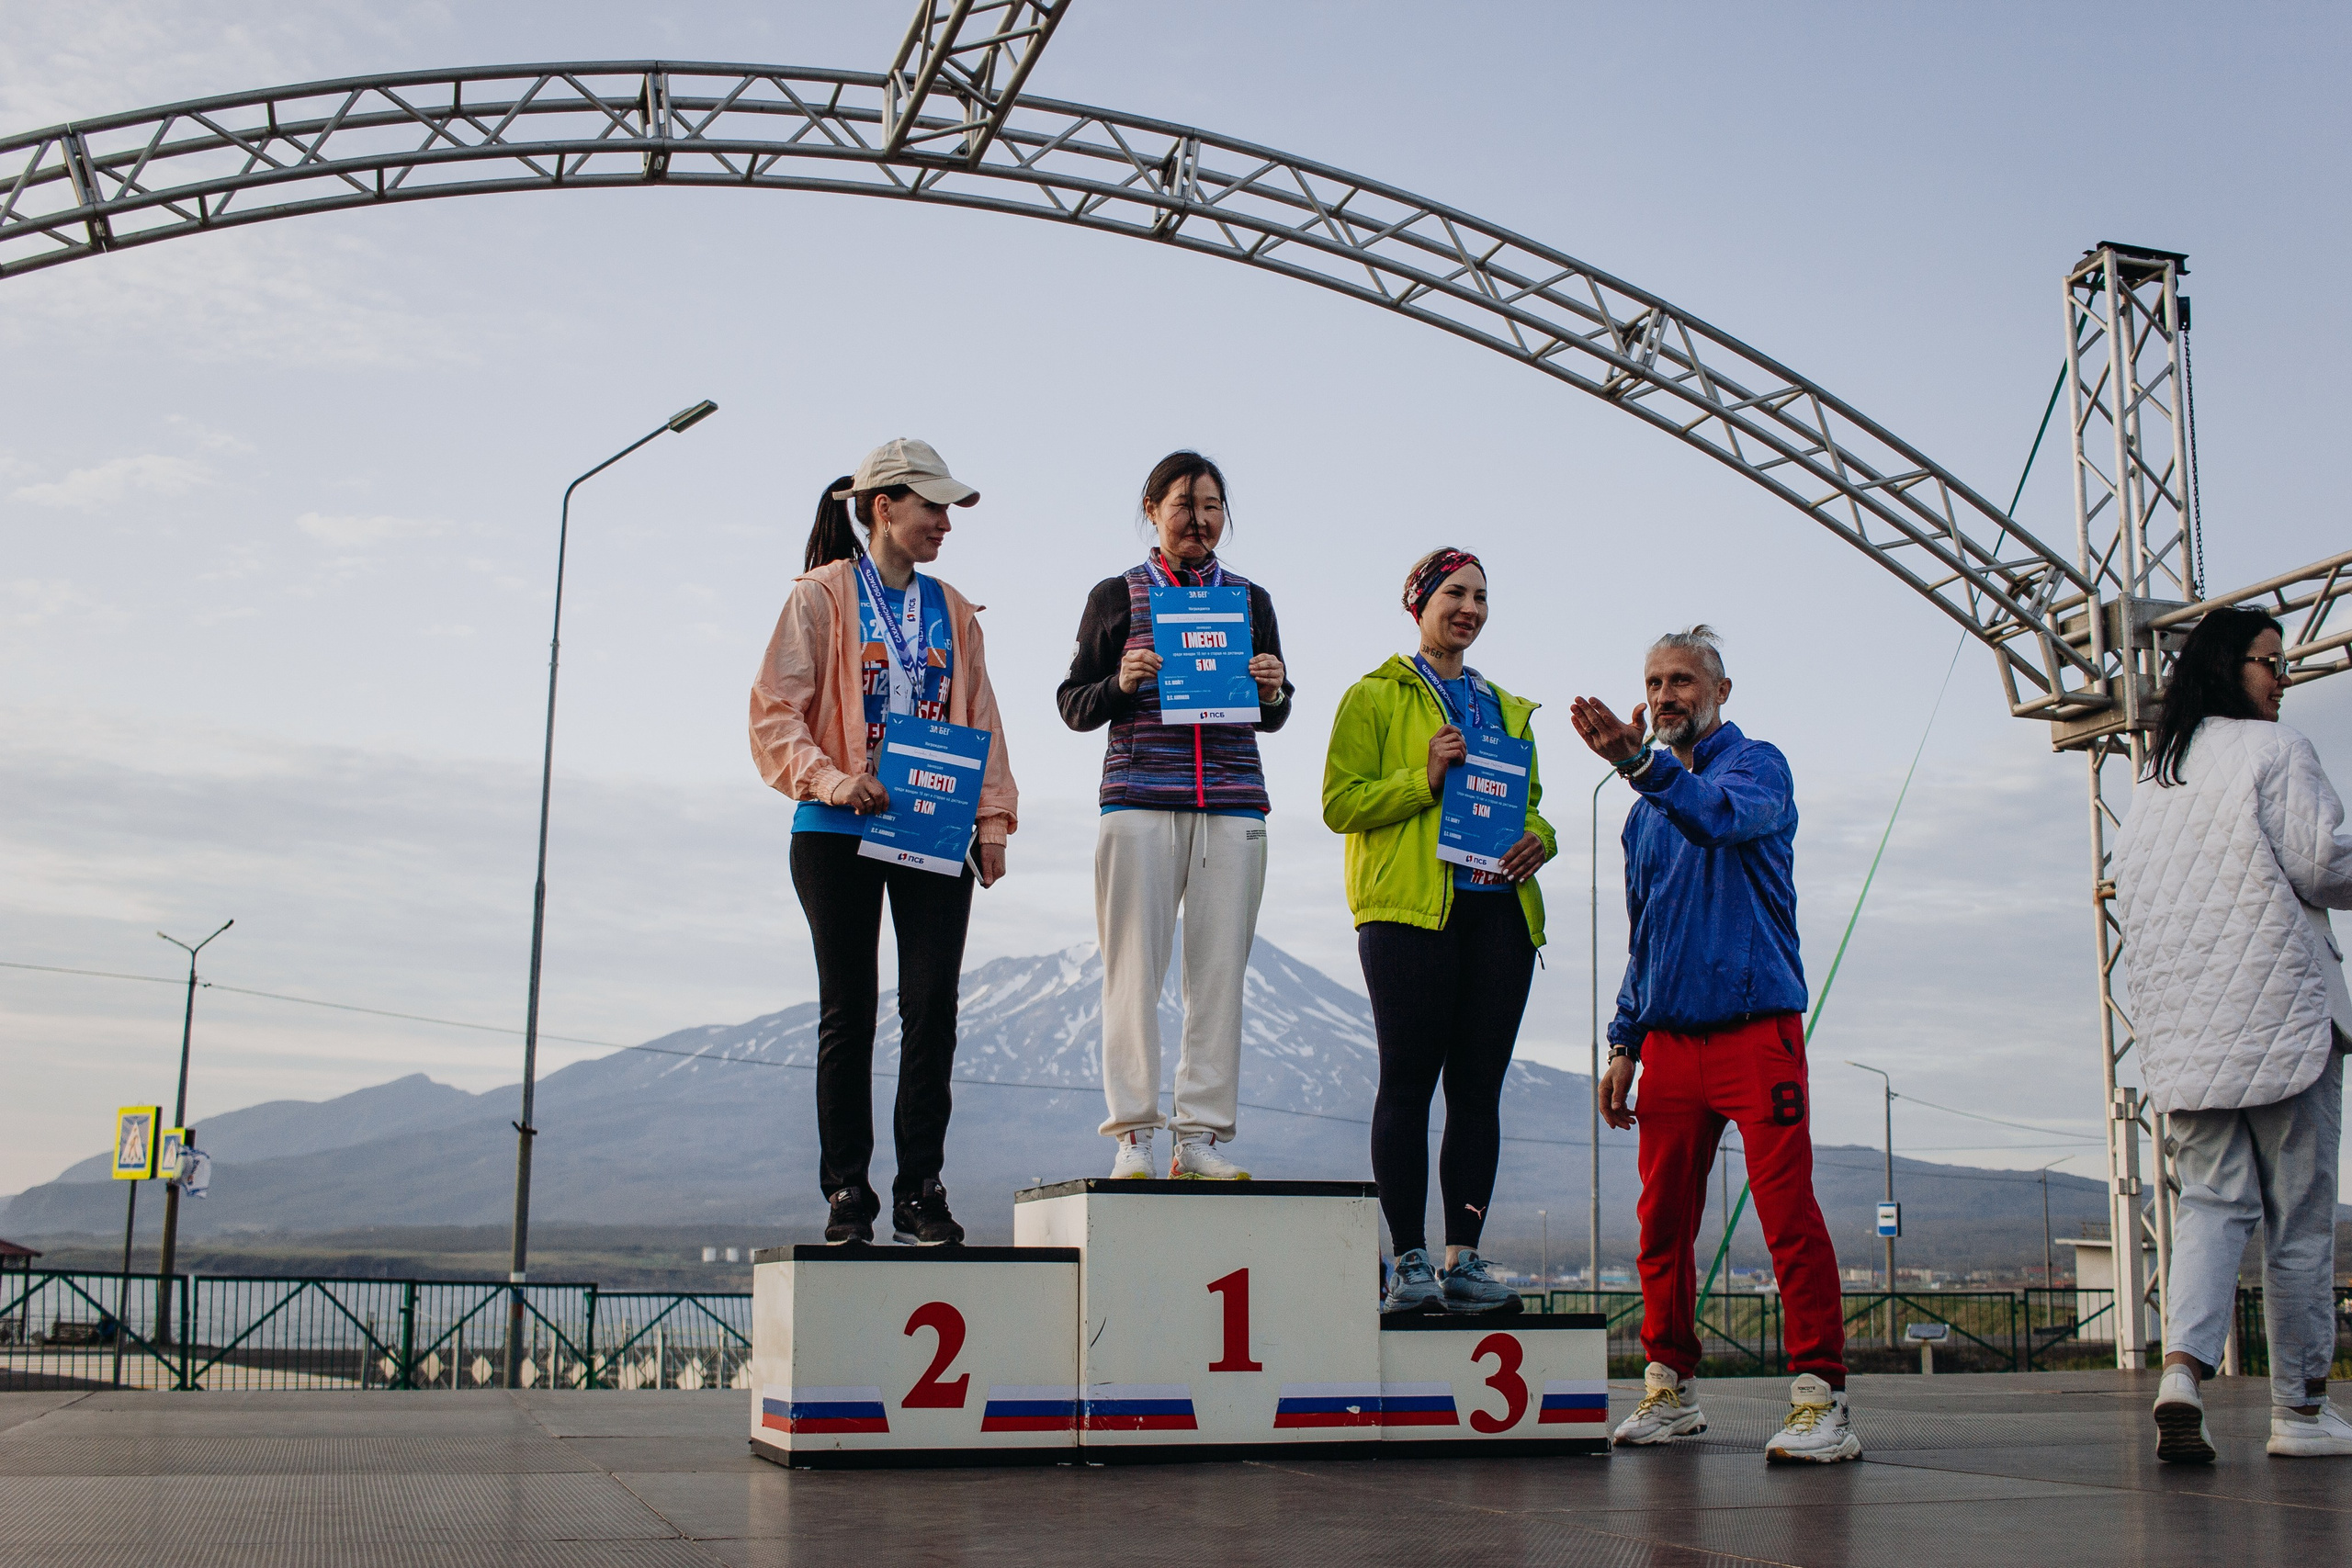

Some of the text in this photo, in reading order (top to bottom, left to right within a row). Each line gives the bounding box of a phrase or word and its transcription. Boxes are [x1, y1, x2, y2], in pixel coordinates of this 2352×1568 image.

[866, 569, 901, 643] САХАЛИНСКАЯ ОБЛАСТЬ
[908, 598, 917, 613] ПСБ
[1187, 631, 1227, 649] МЕСТО
[1430, 648, 1444, 660] БЕГ
[1195, 659, 1216, 671] 5 КМ
[1421, 663, 1440, 685] ОБЛАСТЬ
[908, 768, 956, 794] II МЕСТО
[1466, 774, 1508, 798] III МЕСТО
[913, 798, 936, 816] 5 КМ
[1472, 803, 1477, 816] 5
[1478, 804, 1491, 818] КМ
[908, 856, 924, 864] ПСБ
[1474, 857, 1487, 865] ПСБ
[1770, 1081, 1805, 1126] 8
[1206, 1268, 1262, 1371] 1
[901, 1302, 970, 1408] 2
[1469, 1333, 1528, 1434] 3
